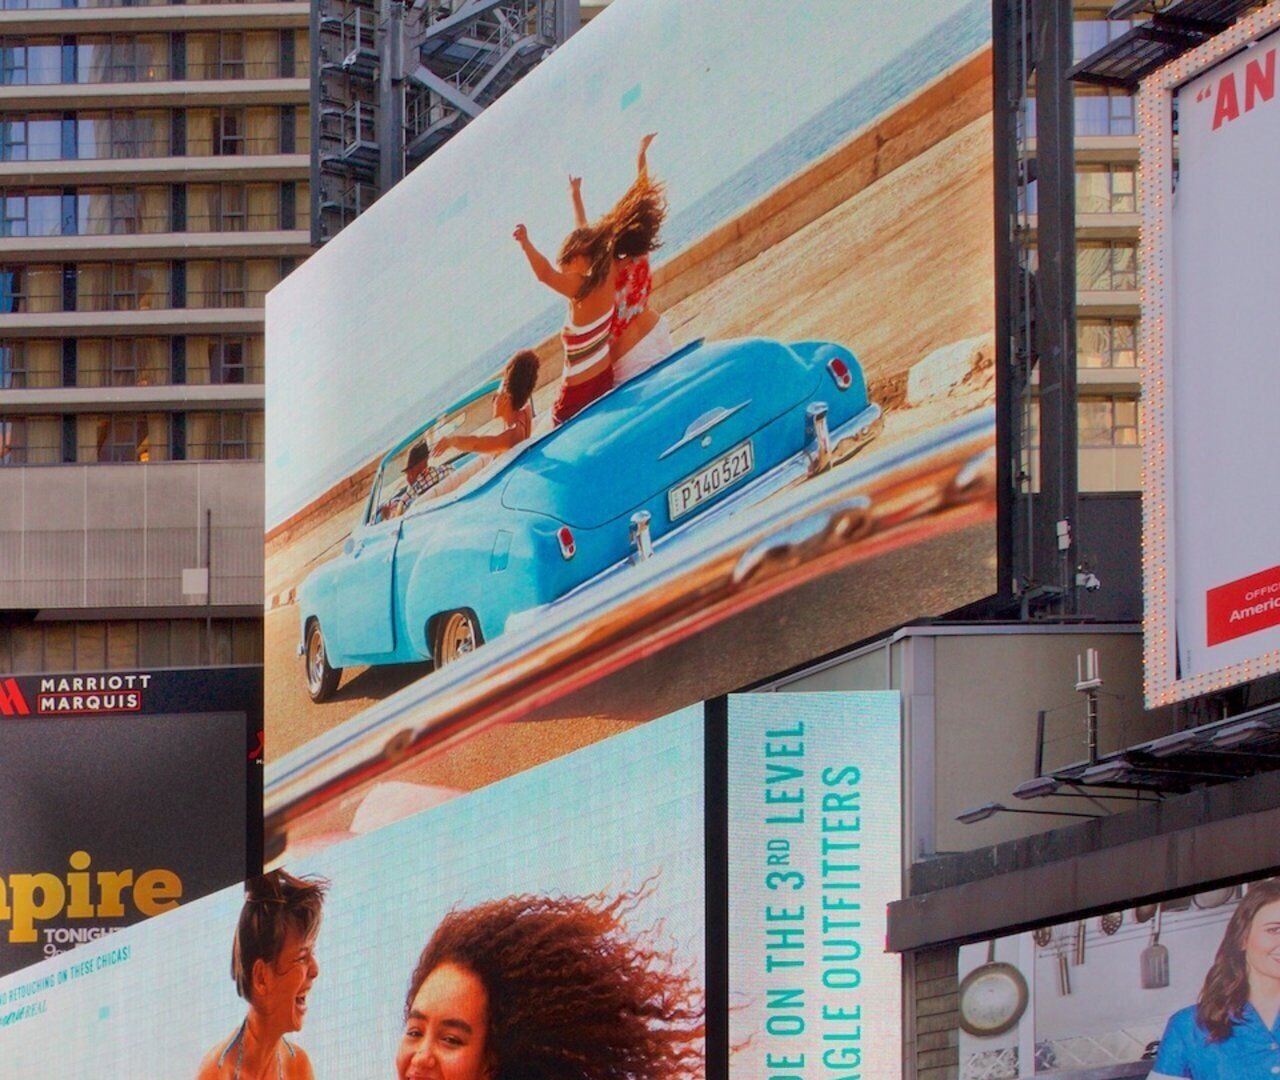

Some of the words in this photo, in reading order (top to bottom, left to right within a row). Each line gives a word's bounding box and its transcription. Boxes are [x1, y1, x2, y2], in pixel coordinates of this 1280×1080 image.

[40, 675, 152, 692] MARRIOTT
[40, 694, 138, 711] MARQUIS
[765, 721, 804, 824] LEVEL
[765, 838, 804, 890] 3RD
[822, 765, 861, 988] OUTFITTERS
[766, 922, 805, 973] THE
[9, 974, 55, 1003] RETOUCHING
[70, 959, 93, 979] THESE
[97, 945, 131, 971] CHICAS!
[766, 992, 805, 1036] ON
